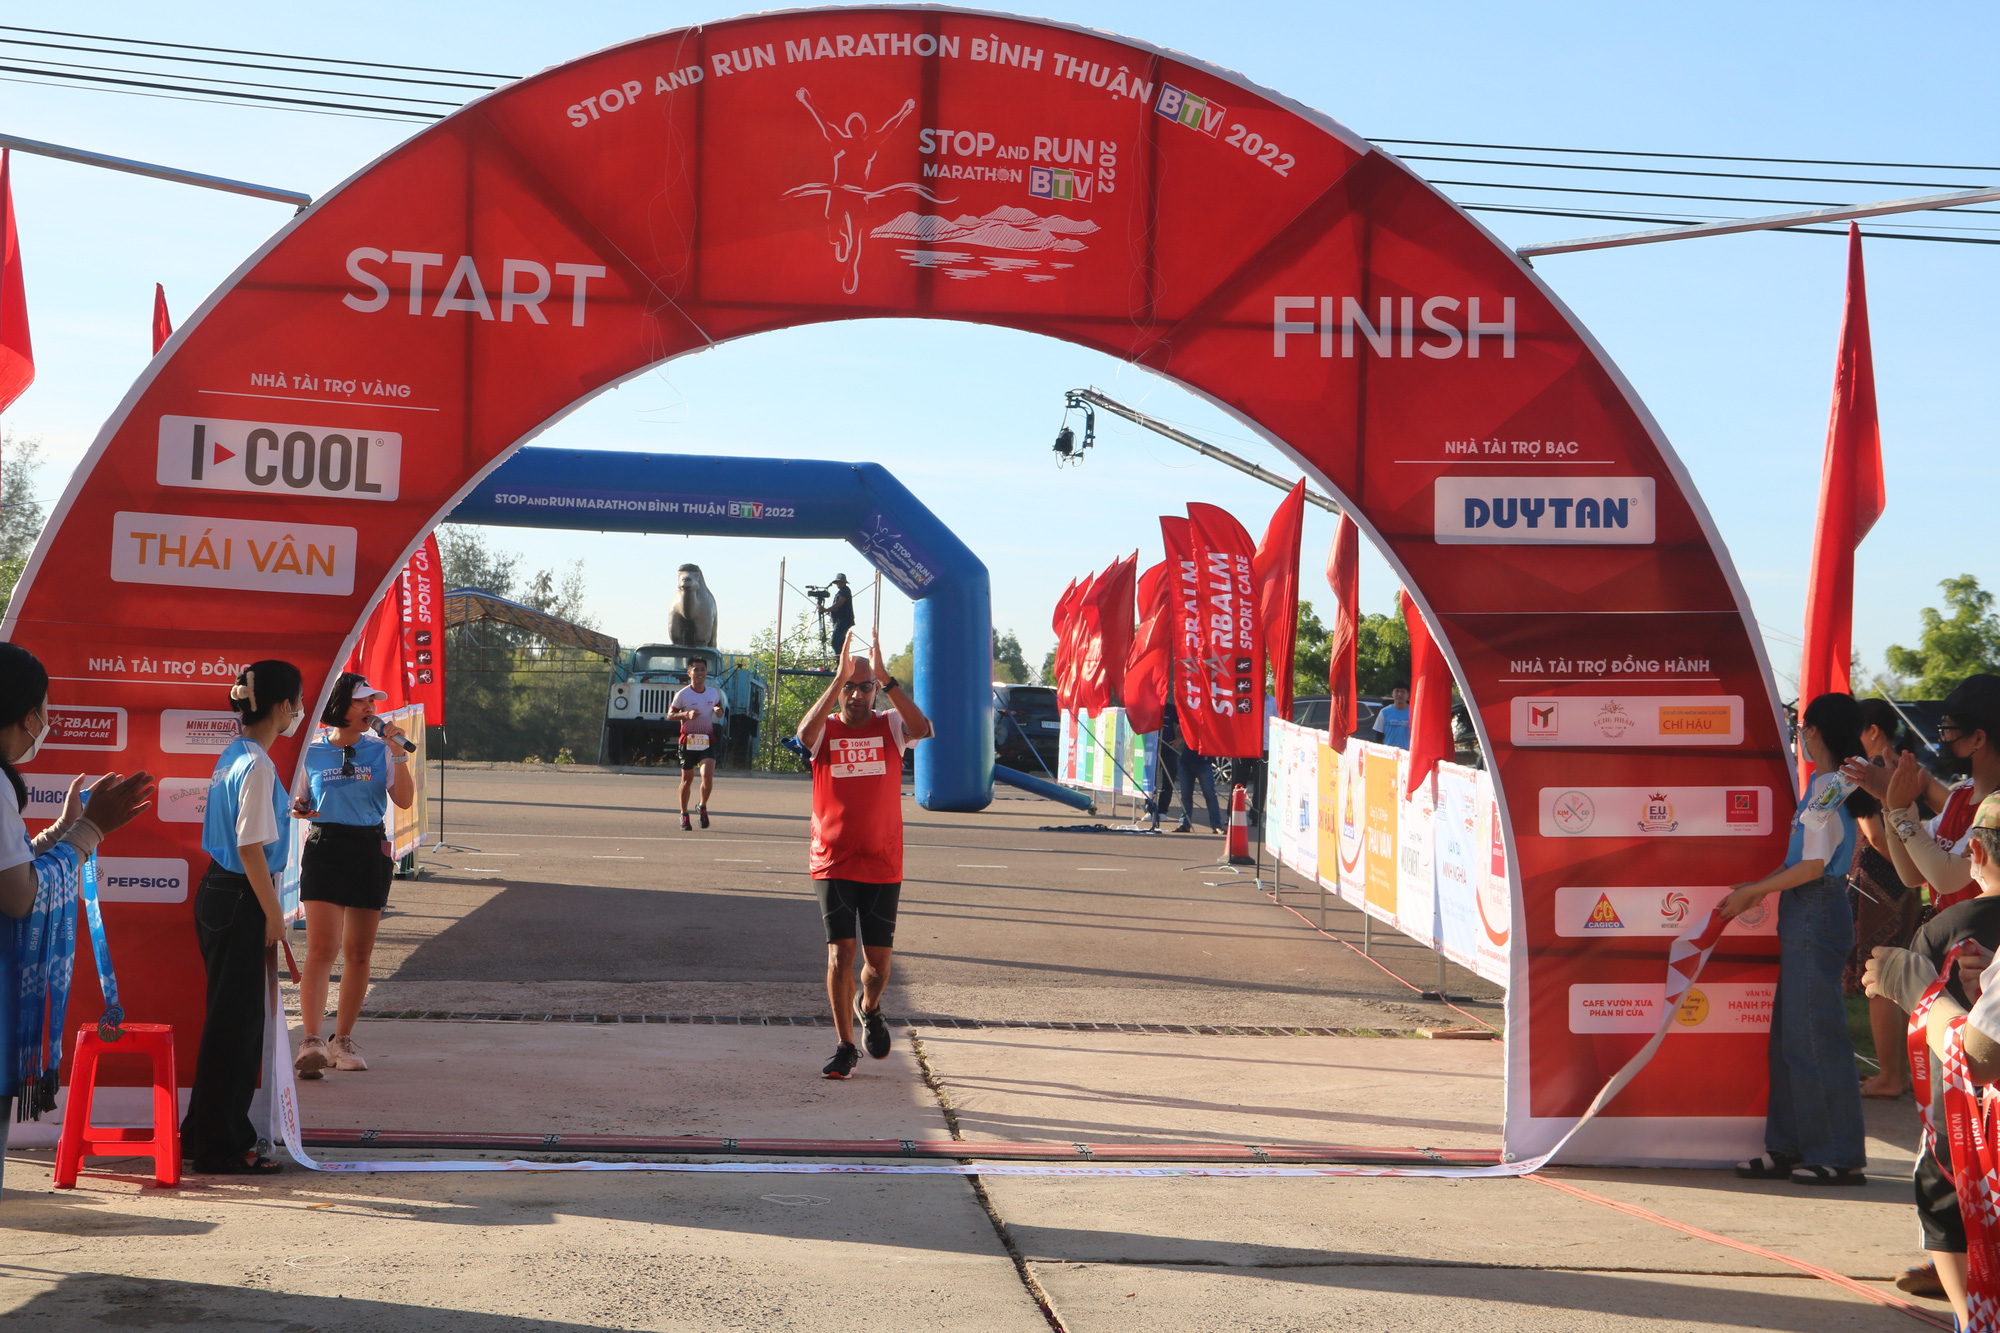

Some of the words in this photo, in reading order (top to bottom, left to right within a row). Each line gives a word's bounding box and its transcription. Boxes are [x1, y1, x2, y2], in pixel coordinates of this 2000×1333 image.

[566, 80, 643, 128] STOP
[654, 65, 704, 96] AND
[711, 43, 777, 78] RUN
[784, 33, 960, 63] MARATHON
[969, 34, 1044, 72] BÌNH
[1053, 52, 1154, 103] THUẬN
[1154, 82, 1227, 139] BTV
[1224, 122, 1296, 178] 2022
[918, 128, 996, 158] STOP
[996, 144, 1030, 161] AND
[1033, 136, 1094, 165] RUN
[923, 163, 1023, 183] MARATHON
[1098, 141, 1117, 194] 2022
[1028, 165, 1093, 203] BTV
[341, 247, 606, 327] START
[1273, 296, 1516, 359] FINISH
[250, 371, 288, 388] NHÀ
[293, 373, 319, 391] TÀI
[324, 378, 357, 397] TRỢ
[361, 379, 411, 398] VÀNG
[245, 428, 382, 494] COOL
[1445, 438, 1479, 454] NHÀ
[1483, 438, 1506, 454] TÀI
[1511, 439, 1541, 458] TRỢ
[1545, 441, 1579, 458] BẠC
[495, 493, 527, 505] STOP
[527, 497, 549, 506] AND
[549, 497, 575, 508] RUN
[576, 498, 648, 512] MARATHON
[648, 499, 679, 513] BÌNH
[683, 501, 725, 517] THUẬN
[728, 501, 763, 520] BTV
[765, 507, 795, 518] 2022
[1464, 497, 1629, 529] DUYTAN
[130, 528, 232, 570] THÁI
[246, 533, 336, 577] VÂN
[893, 542, 912, 559] STOP
[915, 562, 931, 578] RUN
[1236, 554, 1252, 595] CARE
[417, 574, 432, 624] SPORT
[1239, 598, 1253, 651] SPORT
[88, 655, 127, 673] NHÀ
[131, 656, 158, 674] TÀI
[163, 659, 197, 679] TRỢ
[1510, 657, 1544, 673] NHÀ
[1549, 657, 1572, 673] TÀI
[1576, 658, 1607, 677] TRỢ
[1611, 654, 1661, 673] ĐỒNG
[1664, 656, 1710, 673] HÀNH
[63, 730, 89, 738] SPORT
[89, 731, 110, 739] CARE
[186, 720, 209, 731] MINH
[210, 719, 237, 731] NGHĨA
[1663, 718, 1683, 730] CHÍ
[1686, 718, 1712, 731] HẬU
[840, 749, 878, 763] 1084
[355, 766, 372, 774] RUN
[107, 877, 180, 888] PEPSICO
[29, 927, 40, 951] 05KM
[1607, 998, 1633, 1007] VƯỜN
[1728, 1001, 1759, 1012] HẠNH
[1746, 990, 1760, 998] VẬN
[1626, 1008, 1645, 1017] CỬA
[1741, 1014, 1770, 1023] PHAN
[1912, 1050, 1927, 1080] 10KM
[284, 1086, 296, 1135] STOP
[1951, 1113, 1965, 1147] 10KM
[1971, 1117, 1985, 1152] 10KM
